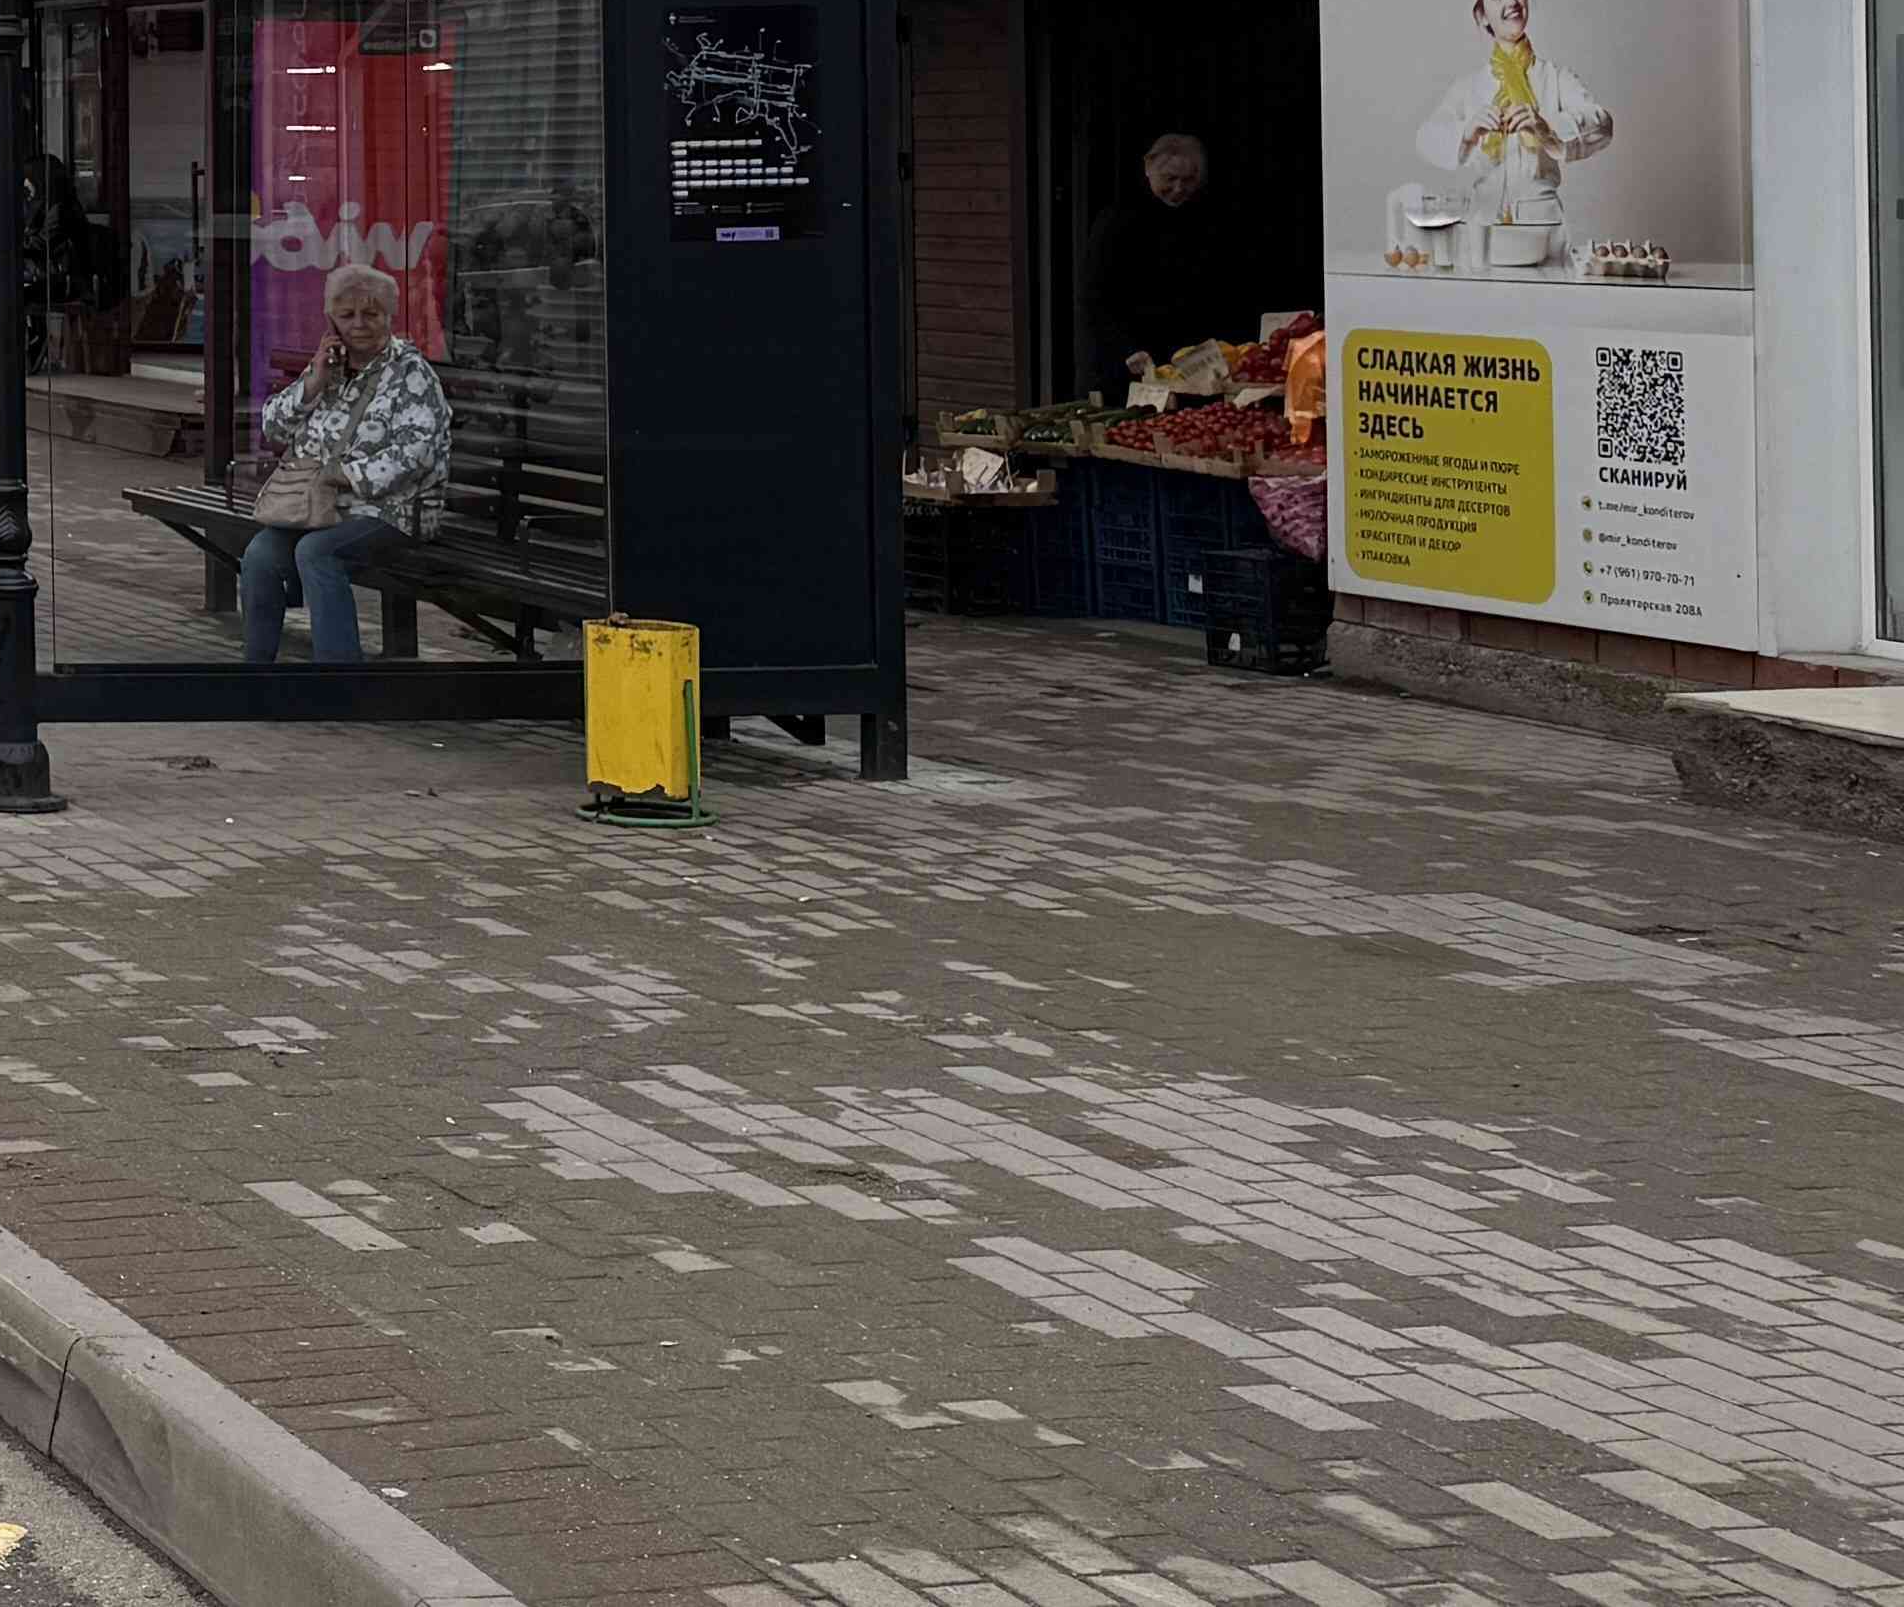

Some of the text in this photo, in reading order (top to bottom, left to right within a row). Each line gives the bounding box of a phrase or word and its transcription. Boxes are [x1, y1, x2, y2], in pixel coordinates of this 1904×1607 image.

[1357, 347, 1540, 382] СЛАДКАЯ ЖИЗНЬ
[1358, 380, 1498, 413] НАЧИНАЕТСЯ
[1359, 412, 1424, 440] ЗДЕСЬ
[1360, 447, 1520, 476] ЗАМОРОЖЕННЫЕ ЯГОДЫ И ПЮРЕ
[1431, 477, 1507, 495] ИНСТРУМЕНТЫ
[1599, 467, 1687, 490] СКАНИРУЙ
[1434, 497, 1455, 510] ДЛЯ
[1457, 500, 1511, 517] ДЕСЕРТОВ
[1360, 509, 1477, 533] МОЛОЧНАЯ ПРОДУКЦИЯ
[1360, 529, 1462, 552] КРАСИТЕЛИ И ДЕКОР
[1361, 550, 1411, 566] УПАКОВКА
[1600, 565, 1612, 575] +7
[1600, 593, 1672, 612] Пролетарская
